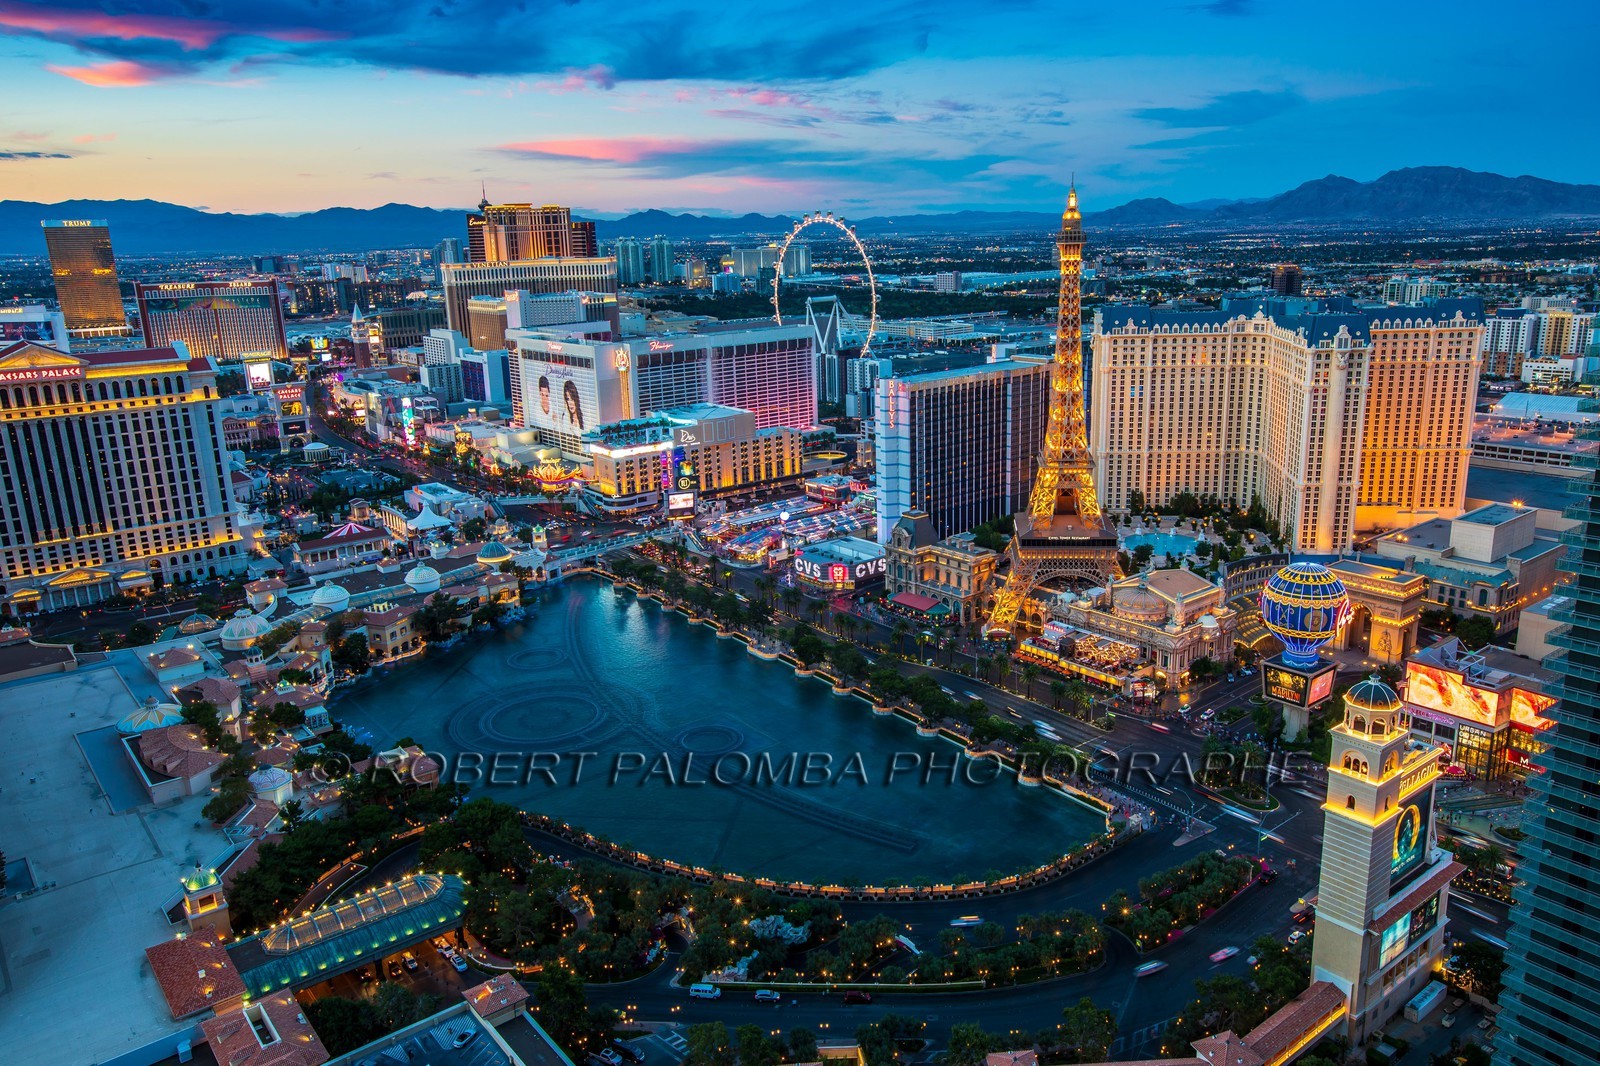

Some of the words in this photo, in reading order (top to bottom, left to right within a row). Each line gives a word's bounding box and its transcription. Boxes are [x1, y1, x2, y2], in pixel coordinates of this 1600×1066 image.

[0, 371, 38, 381] AESARS
[42, 368, 81, 378] PALACE
[794, 557, 821, 578] CVS
[855, 557, 887, 578] CVS
[1459, 724, 1487, 737] URBAN
[1520, 756, 1529, 766] M
